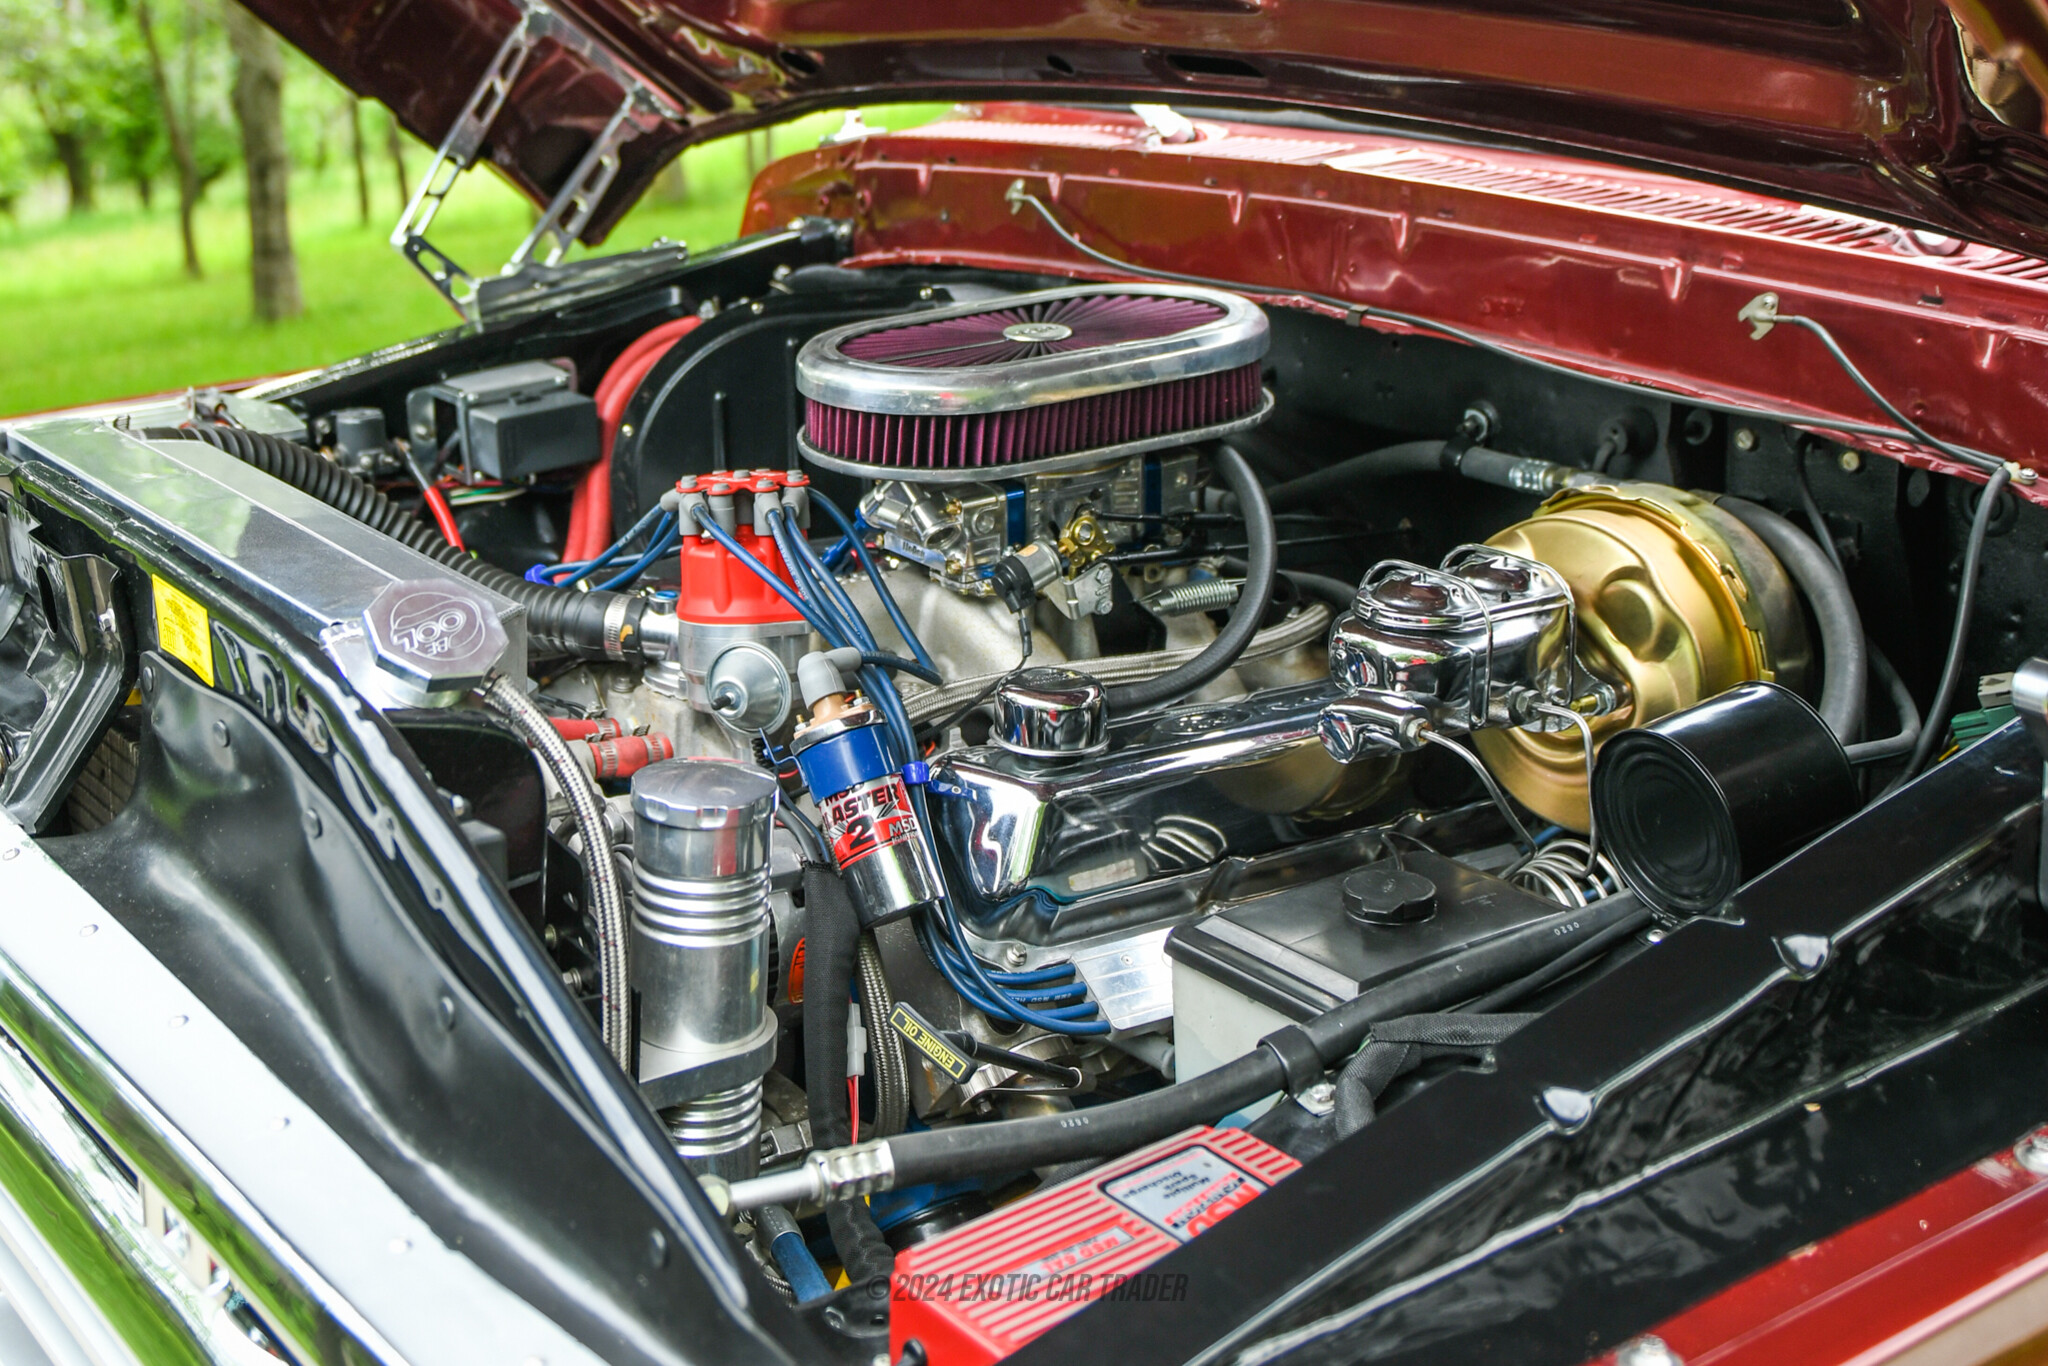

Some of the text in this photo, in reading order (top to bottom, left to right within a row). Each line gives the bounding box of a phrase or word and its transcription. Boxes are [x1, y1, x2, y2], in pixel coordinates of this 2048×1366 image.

[847, 815, 876, 850] 2
[888, 817, 917, 837] MSD
[903, 1017, 956, 1069] ENGINE OIL
[1122, 1171, 1182, 1199] Discharge
[1163, 1177, 1211, 1200] Multiple
[1079, 1235, 1120, 1259] MSD
